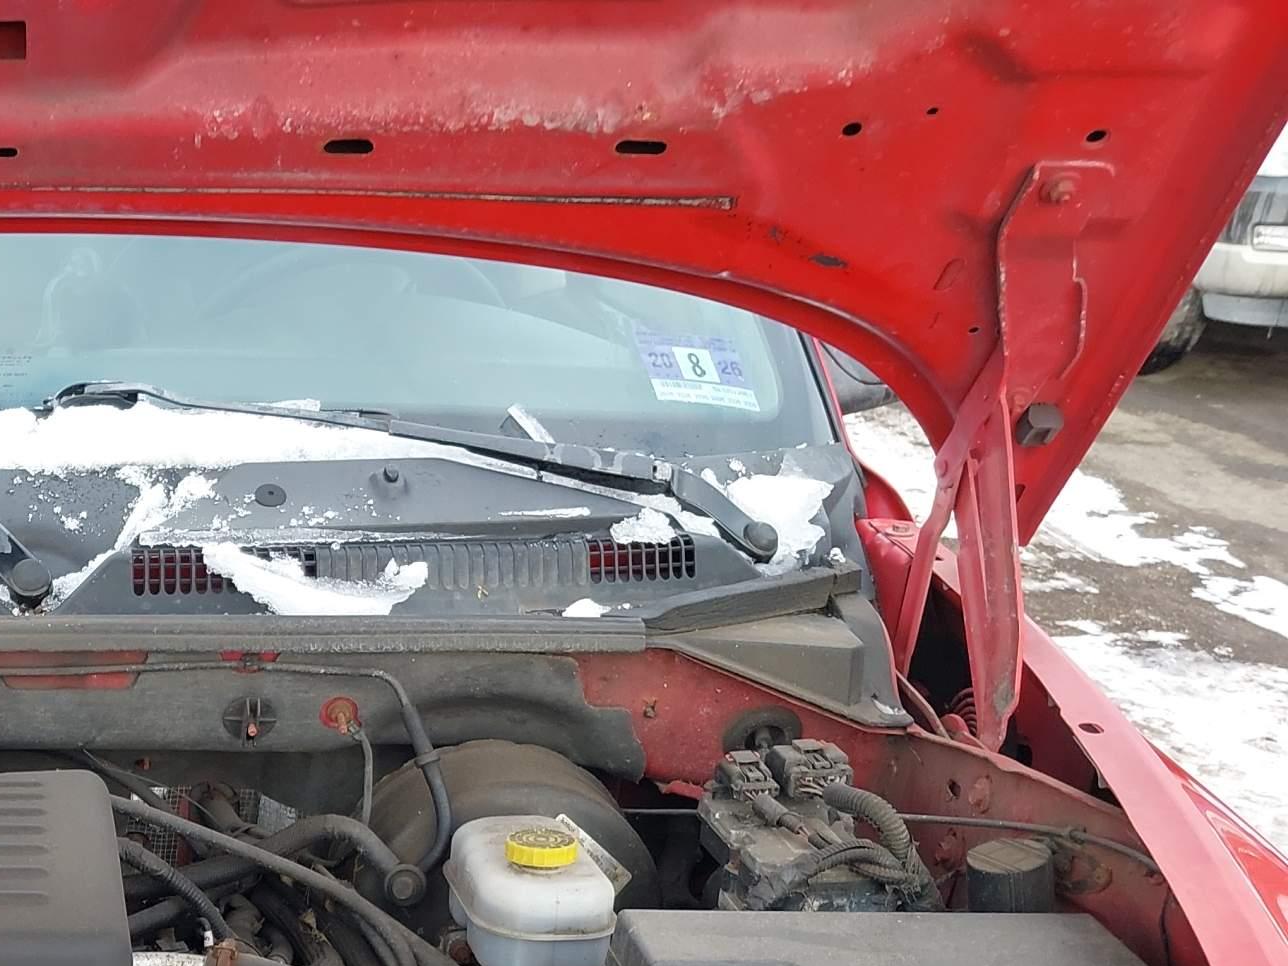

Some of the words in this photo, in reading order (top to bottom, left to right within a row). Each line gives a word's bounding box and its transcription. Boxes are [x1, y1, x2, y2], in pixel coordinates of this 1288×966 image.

[648, 352, 673, 369] 20
[688, 352, 707, 378] 8
[718, 360, 743, 377] 26
